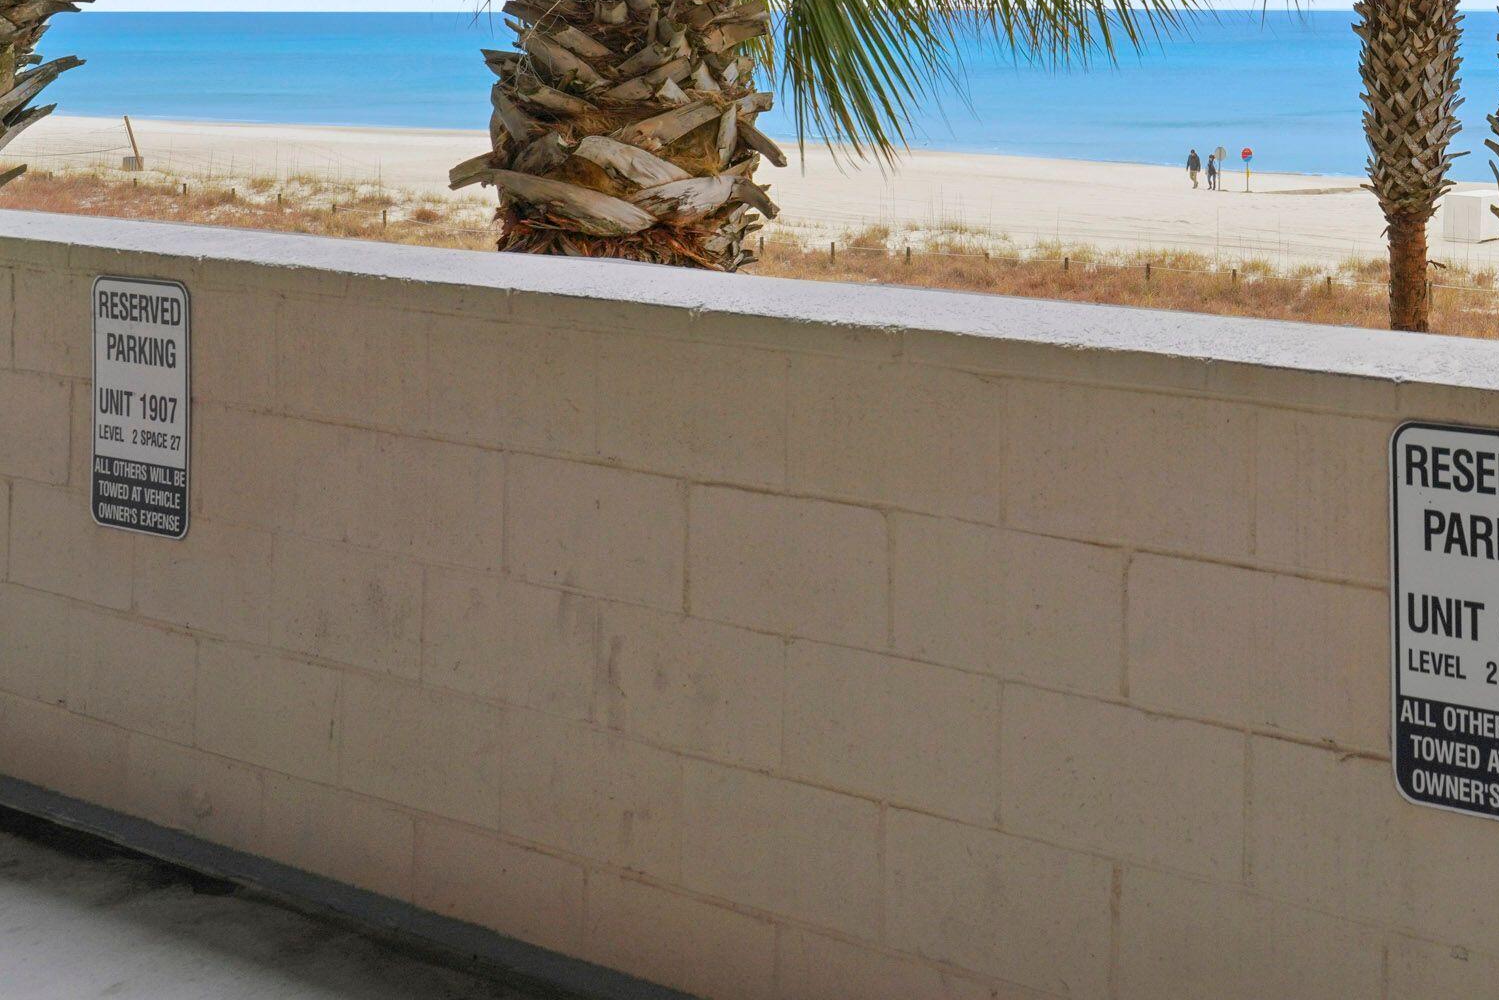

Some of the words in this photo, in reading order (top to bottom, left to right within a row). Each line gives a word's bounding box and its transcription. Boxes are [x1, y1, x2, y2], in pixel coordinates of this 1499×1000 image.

[100, 291, 181, 326] RESERVED
[107, 333, 176, 368] PARKING
[100, 388, 132, 417] UNIT
[140, 394, 177, 423] 1907
[99, 425, 124, 442] LEVEL
[133, 430, 138, 444] 2
[141, 430, 167, 448] SPACE
[171, 436, 180, 451] 27
[94, 457, 110, 475] ALL
[113, 461, 147, 480] OTHERS
[150, 466, 171, 485] WILL
[174, 470, 185, 487] BE
[99, 480, 128, 499] TOWED
[132, 487, 141, 501] AT
[145, 488, 180, 509] VEHICLE
[99, 502, 137, 524] OWNER'S
[140, 510, 179, 532] EXPENSE
[1407, 593, 1484, 641] UNIT
[1408, 649, 1466, 680] LEVEL
[1486, 662, 1497, 685] 2
[1401, 700, 1436, 728] ALL
[1411, 734, 1479, 769] TOWED
